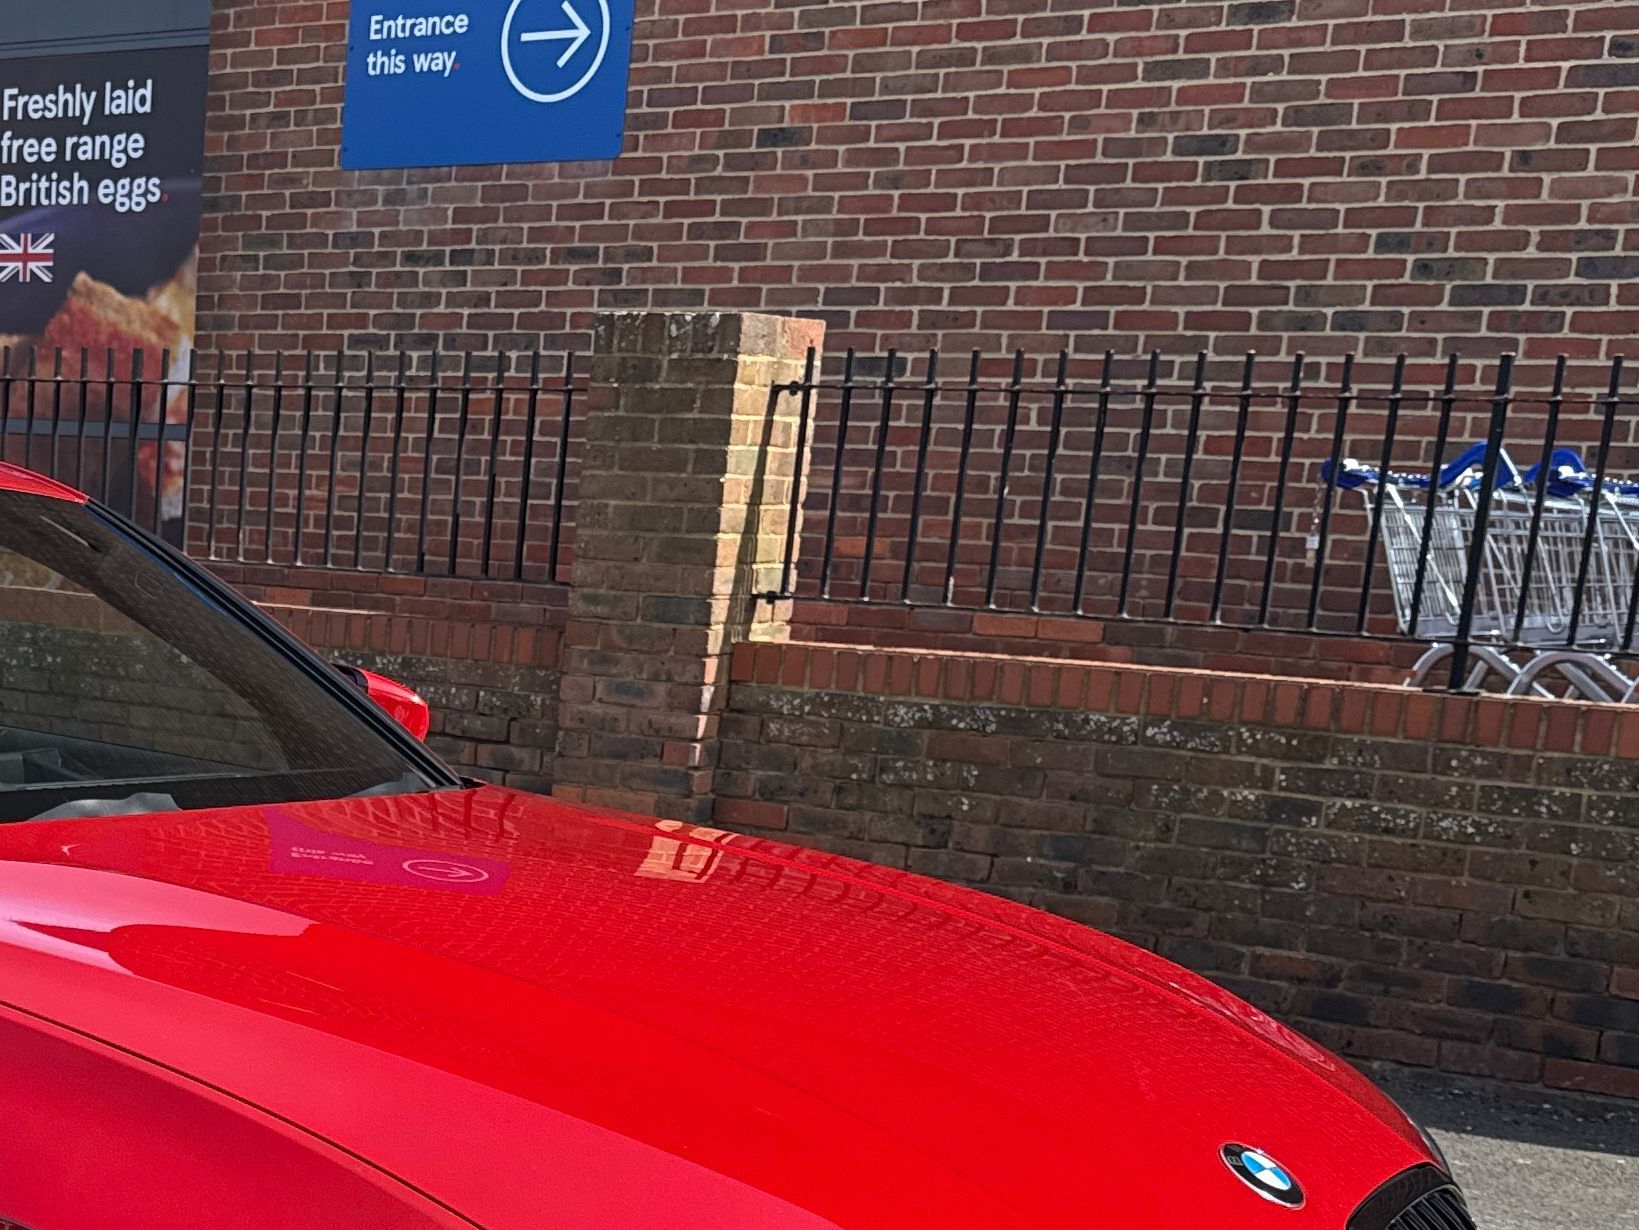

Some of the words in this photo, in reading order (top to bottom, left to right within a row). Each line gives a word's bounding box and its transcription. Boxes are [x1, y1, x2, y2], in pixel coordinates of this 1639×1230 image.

[369, 14, 470, 41] Entrance
[366, 48, 406, 76] this
[2, 83, 97, 126] Freshly
[104, 78, 153, 116] laid
[0, 131, 58, 164] free
[65, 132, 146, 169] range
[0, 171, 90, 207] British
